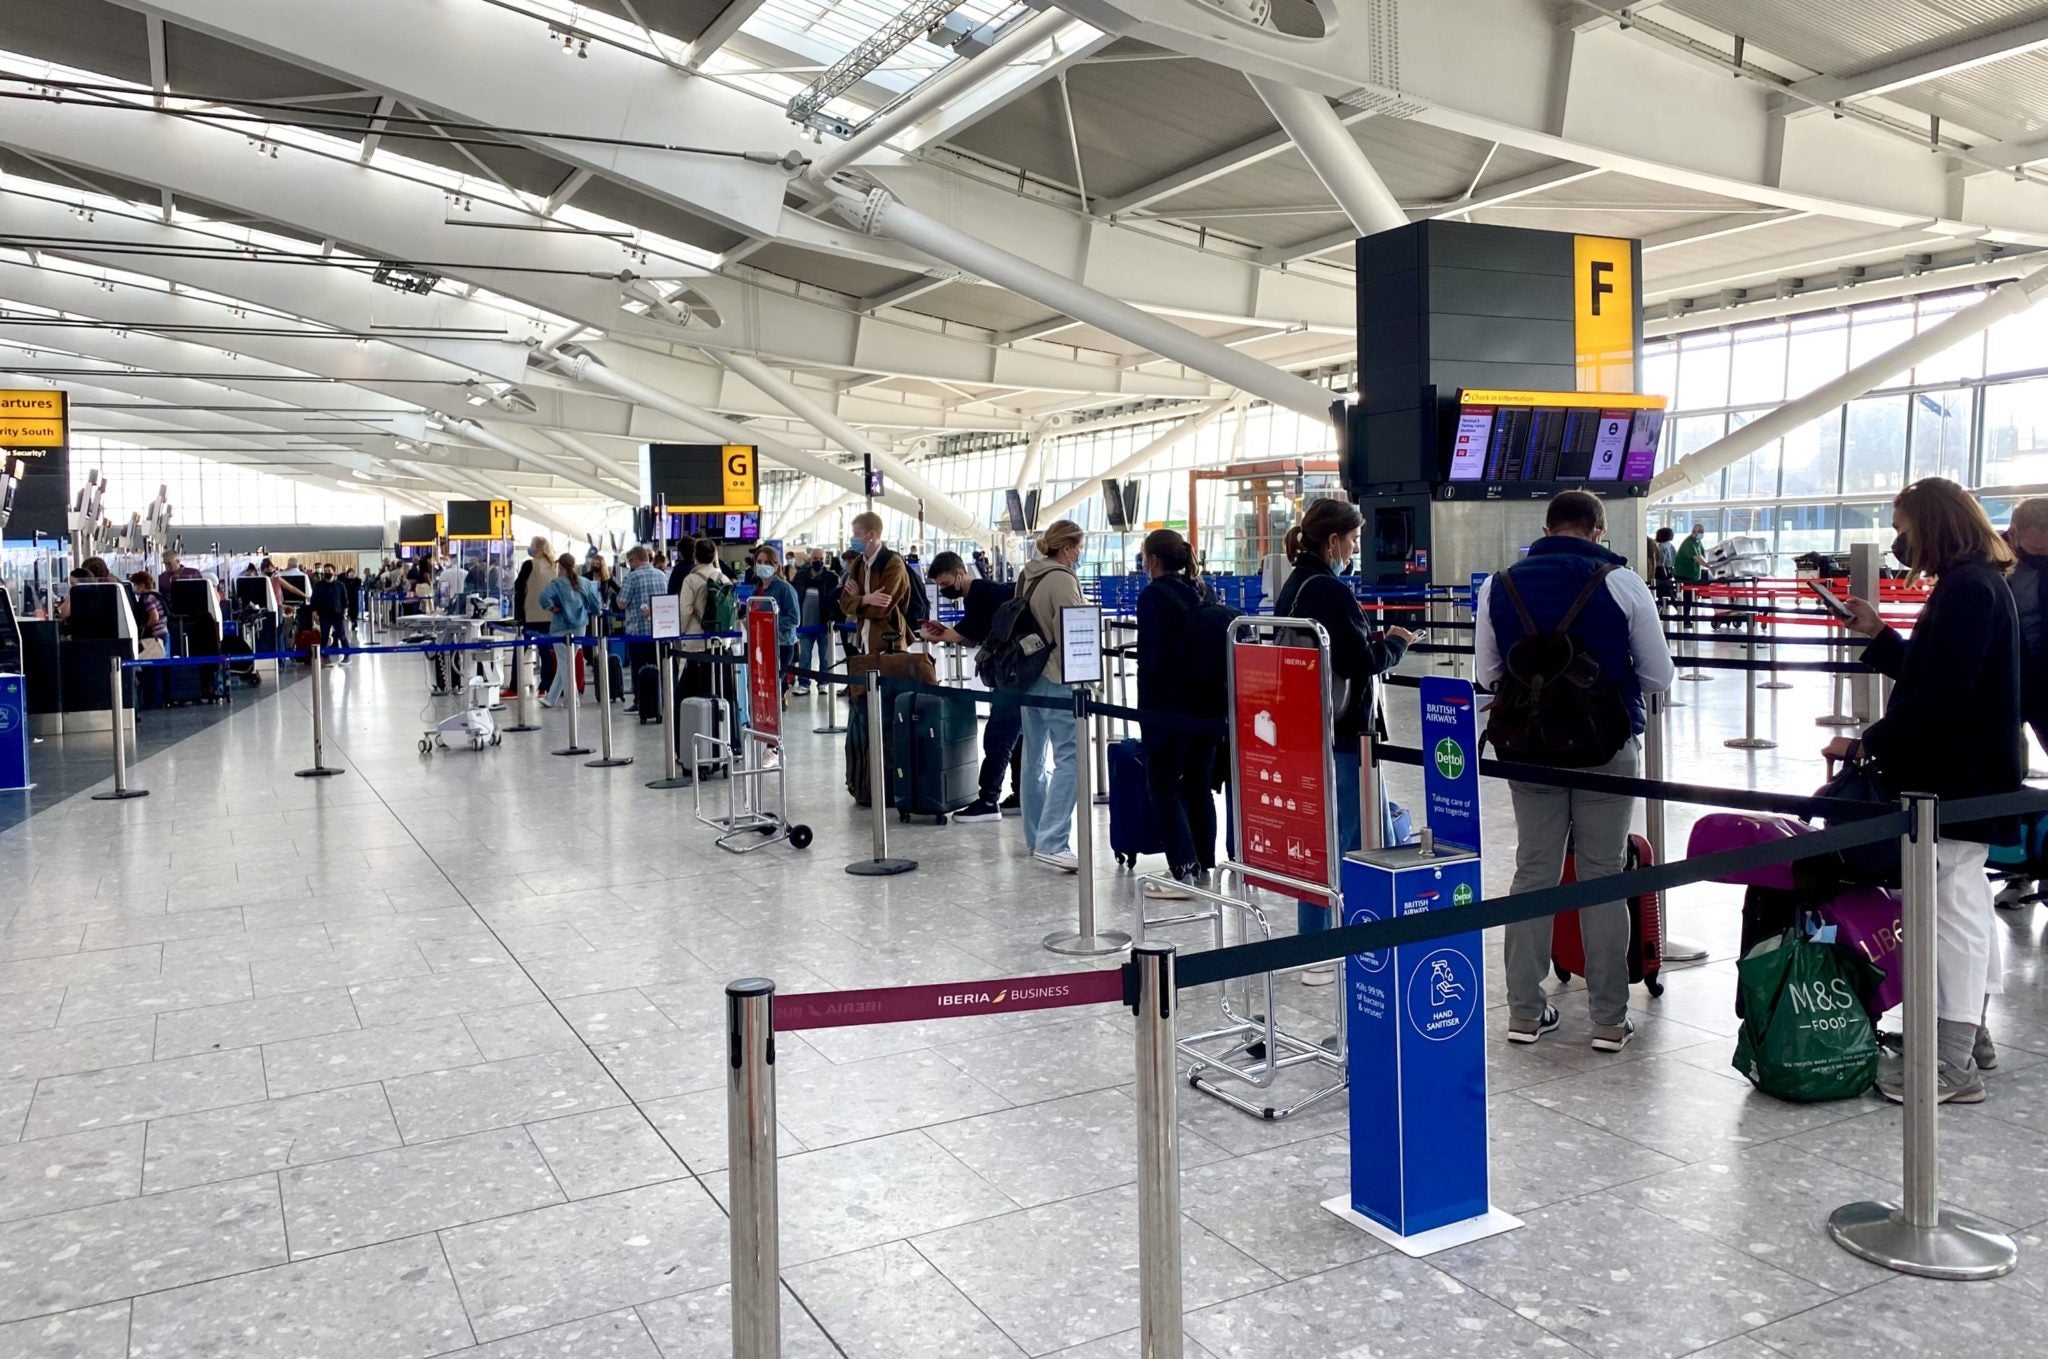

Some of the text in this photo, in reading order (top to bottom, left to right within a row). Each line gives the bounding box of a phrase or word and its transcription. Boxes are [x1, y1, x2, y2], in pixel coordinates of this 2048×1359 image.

[1591, 260, 1614, 316] F
[1, 398, 53, 409] artures
[22, 427, 54, 436] South
[12, 449, 47, 457] Security?
[728, 454, 747, 476] G
[494, 505, 505, 518] H
[1284, 658, 1307, 667] IBERIA
[1426, 703, 1457, 715] BRITISH
[1426, 712, 1458, 724] AIRWAYS
[1436, 751, 1463, 767] Dettol
[1432, 793, 1471, 808] Taking care of
[1434, 804, 1470, 818] you together
[1454, 893, 1472, 902] Dettol
[1404, 899, 1428, 909] BRITISH
[1403, 907, 1430, 916] AIRWAYS
[1356, 982, 1367, 992] Kills
[938, 985, 1070, 1006] IBERIA BUSINESS
[1356, 993, 1385, 1010] of bacteria
[1789, 978, 1853, 1015] M&S
[1358, 1003, 1364, 1012] &
[1433, 1010, 1452, 1020] HAND
[1426, 1017, 1460, 1031] SANITISER
[1811, 1016, 1848, 1032] FOOD
